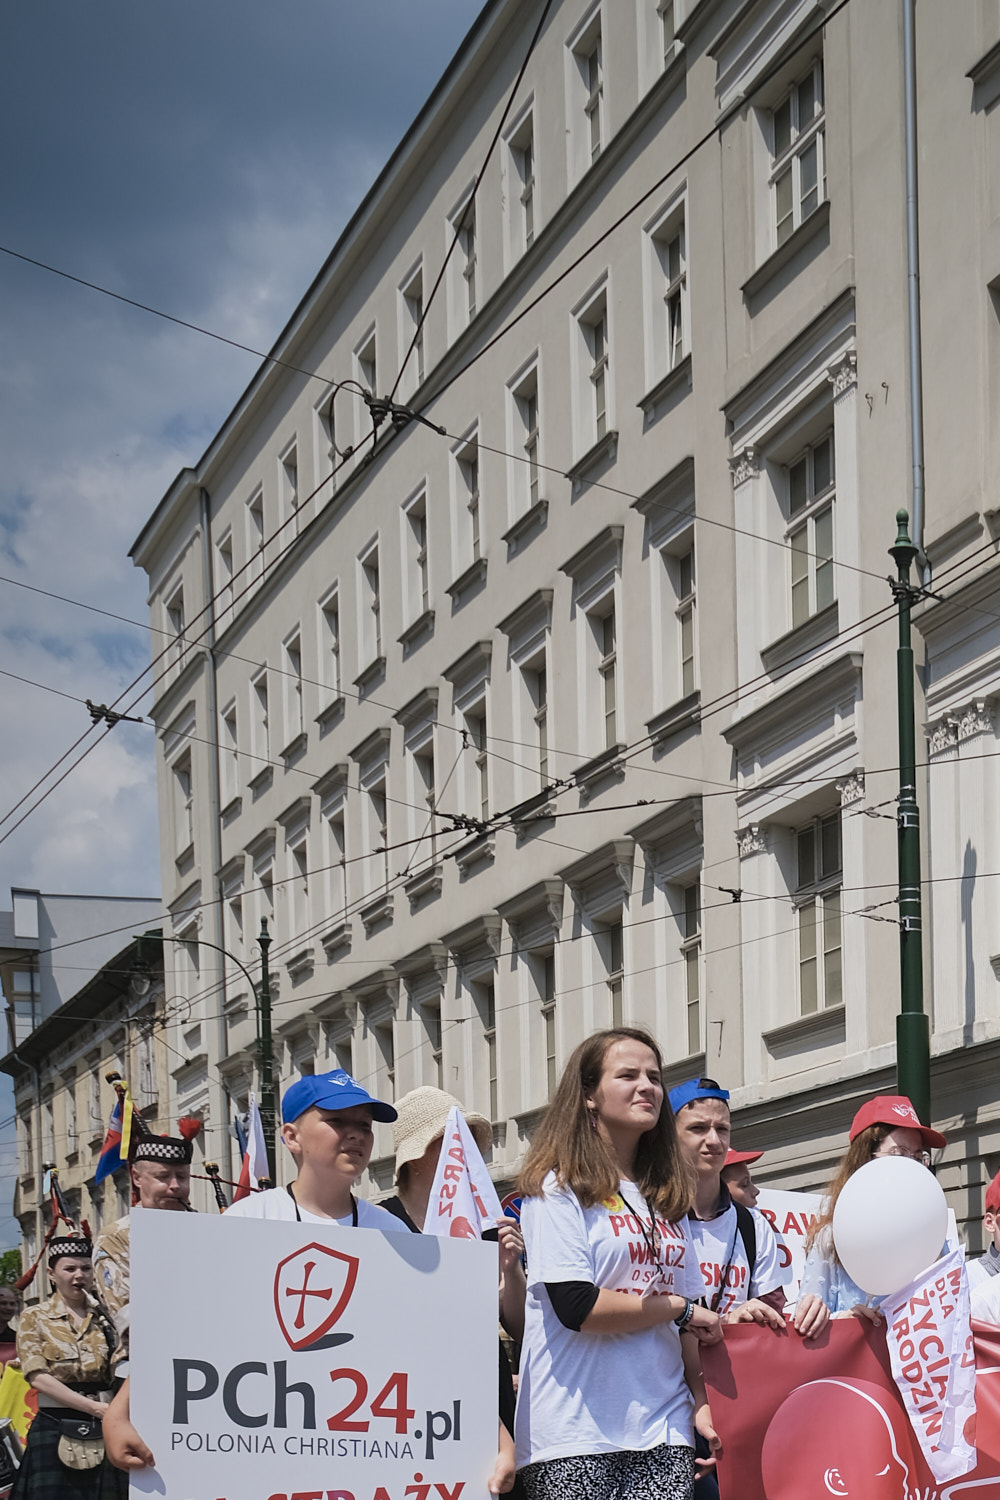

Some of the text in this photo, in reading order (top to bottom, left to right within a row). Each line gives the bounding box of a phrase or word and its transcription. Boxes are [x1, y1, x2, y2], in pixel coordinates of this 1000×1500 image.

[934, 1277, 955, 1319] DLA
[172, 1358, 461, 1460] PCh24.pl
[892, 1317, 944, 1453] RODZIN
[171, 1432, 414, 1460] POLONIA CHRISTIANA
